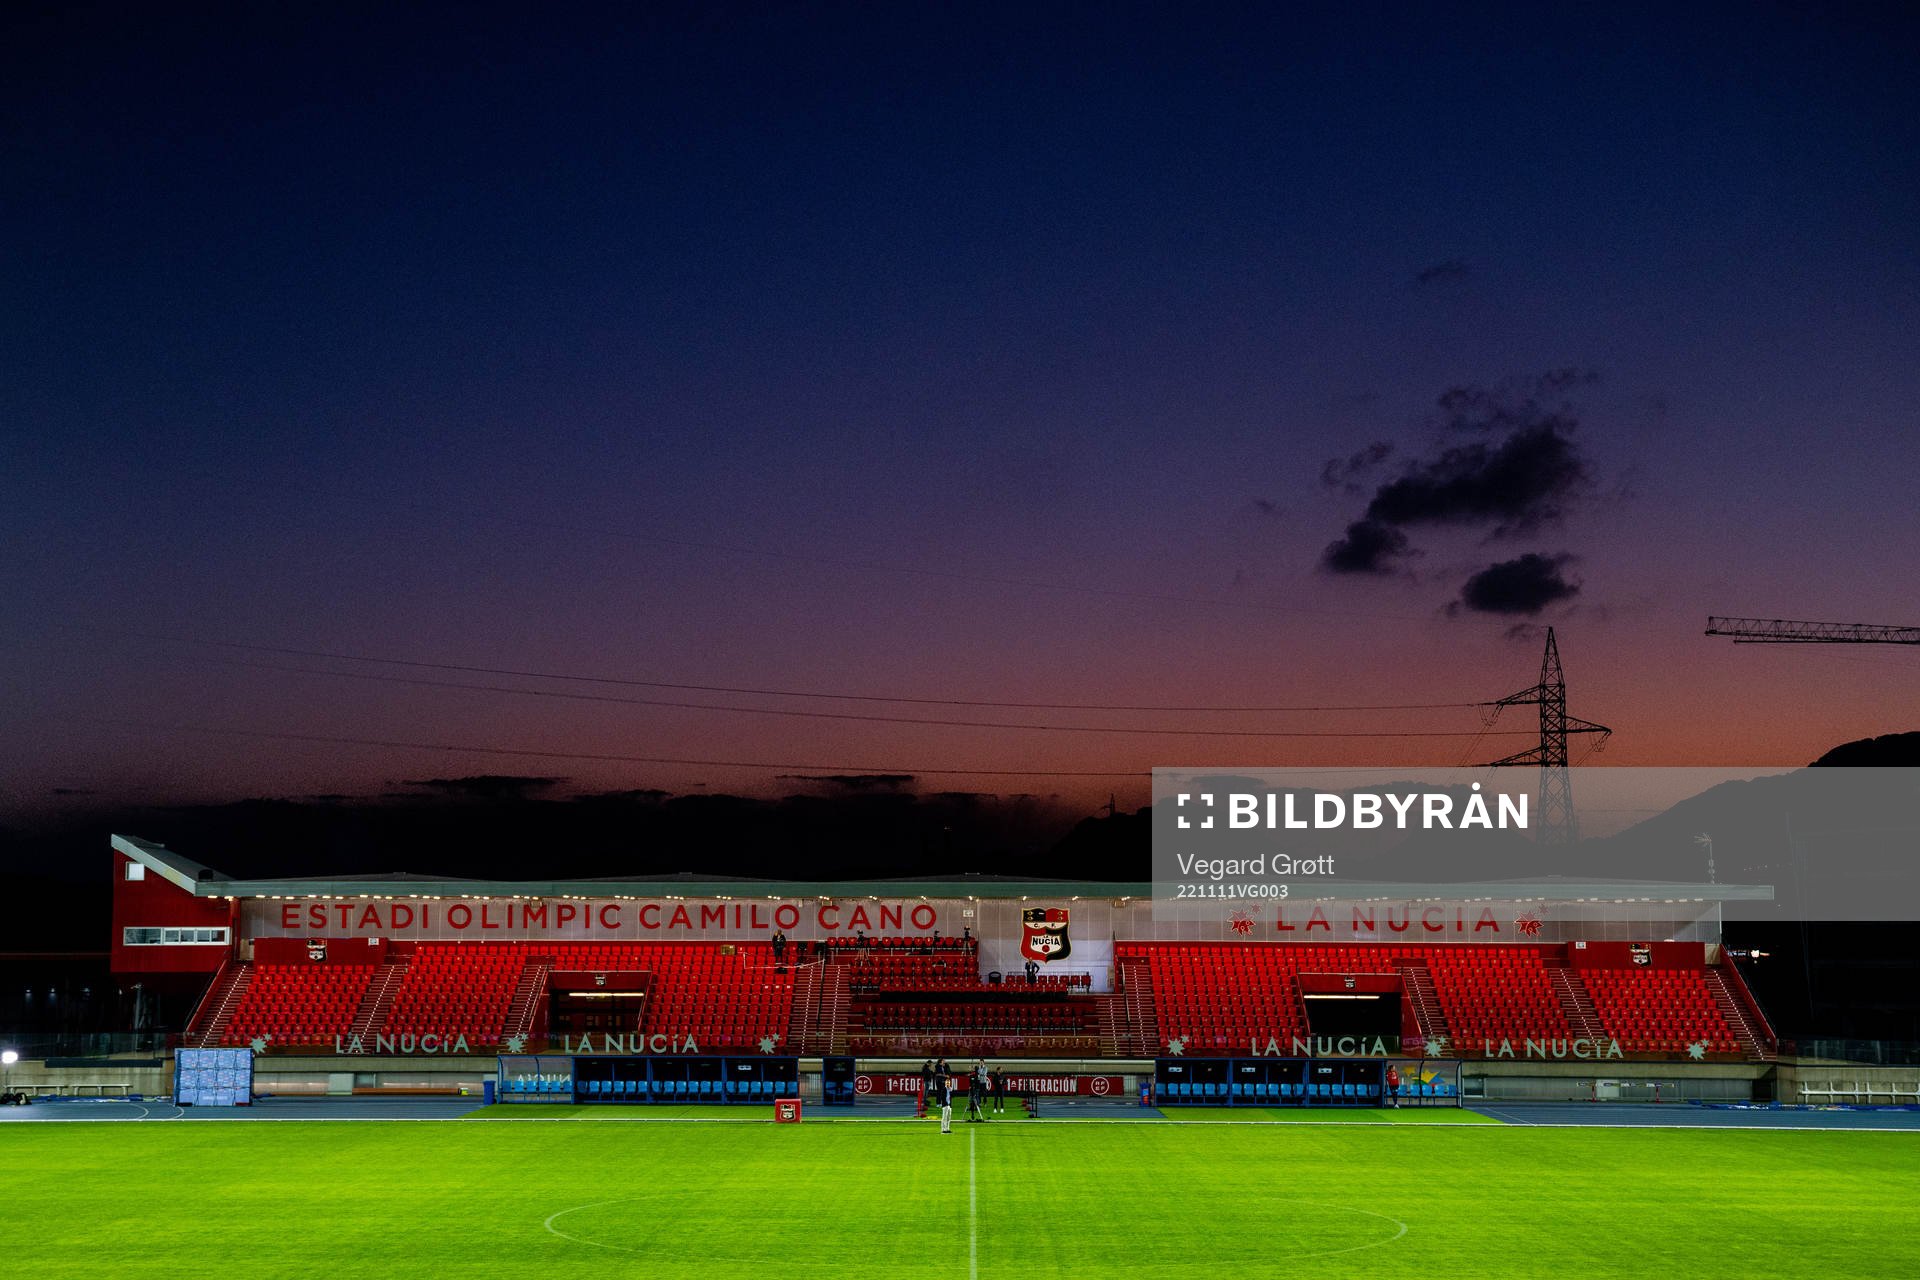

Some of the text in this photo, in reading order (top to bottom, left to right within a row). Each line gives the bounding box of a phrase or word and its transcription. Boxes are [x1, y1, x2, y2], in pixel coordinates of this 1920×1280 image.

[281, 904, 937, 930] ESTADI OLIMPIC CAMILO CANO
[1277, 906, 1500, 932] LA NUCIA
[336, 1033, 365, 1054] LA
[564, 1033, 594, 1053] LA
[1251, 1036, 1281, 1056] LA
[1485, 1037, 1515, 1058] LA
